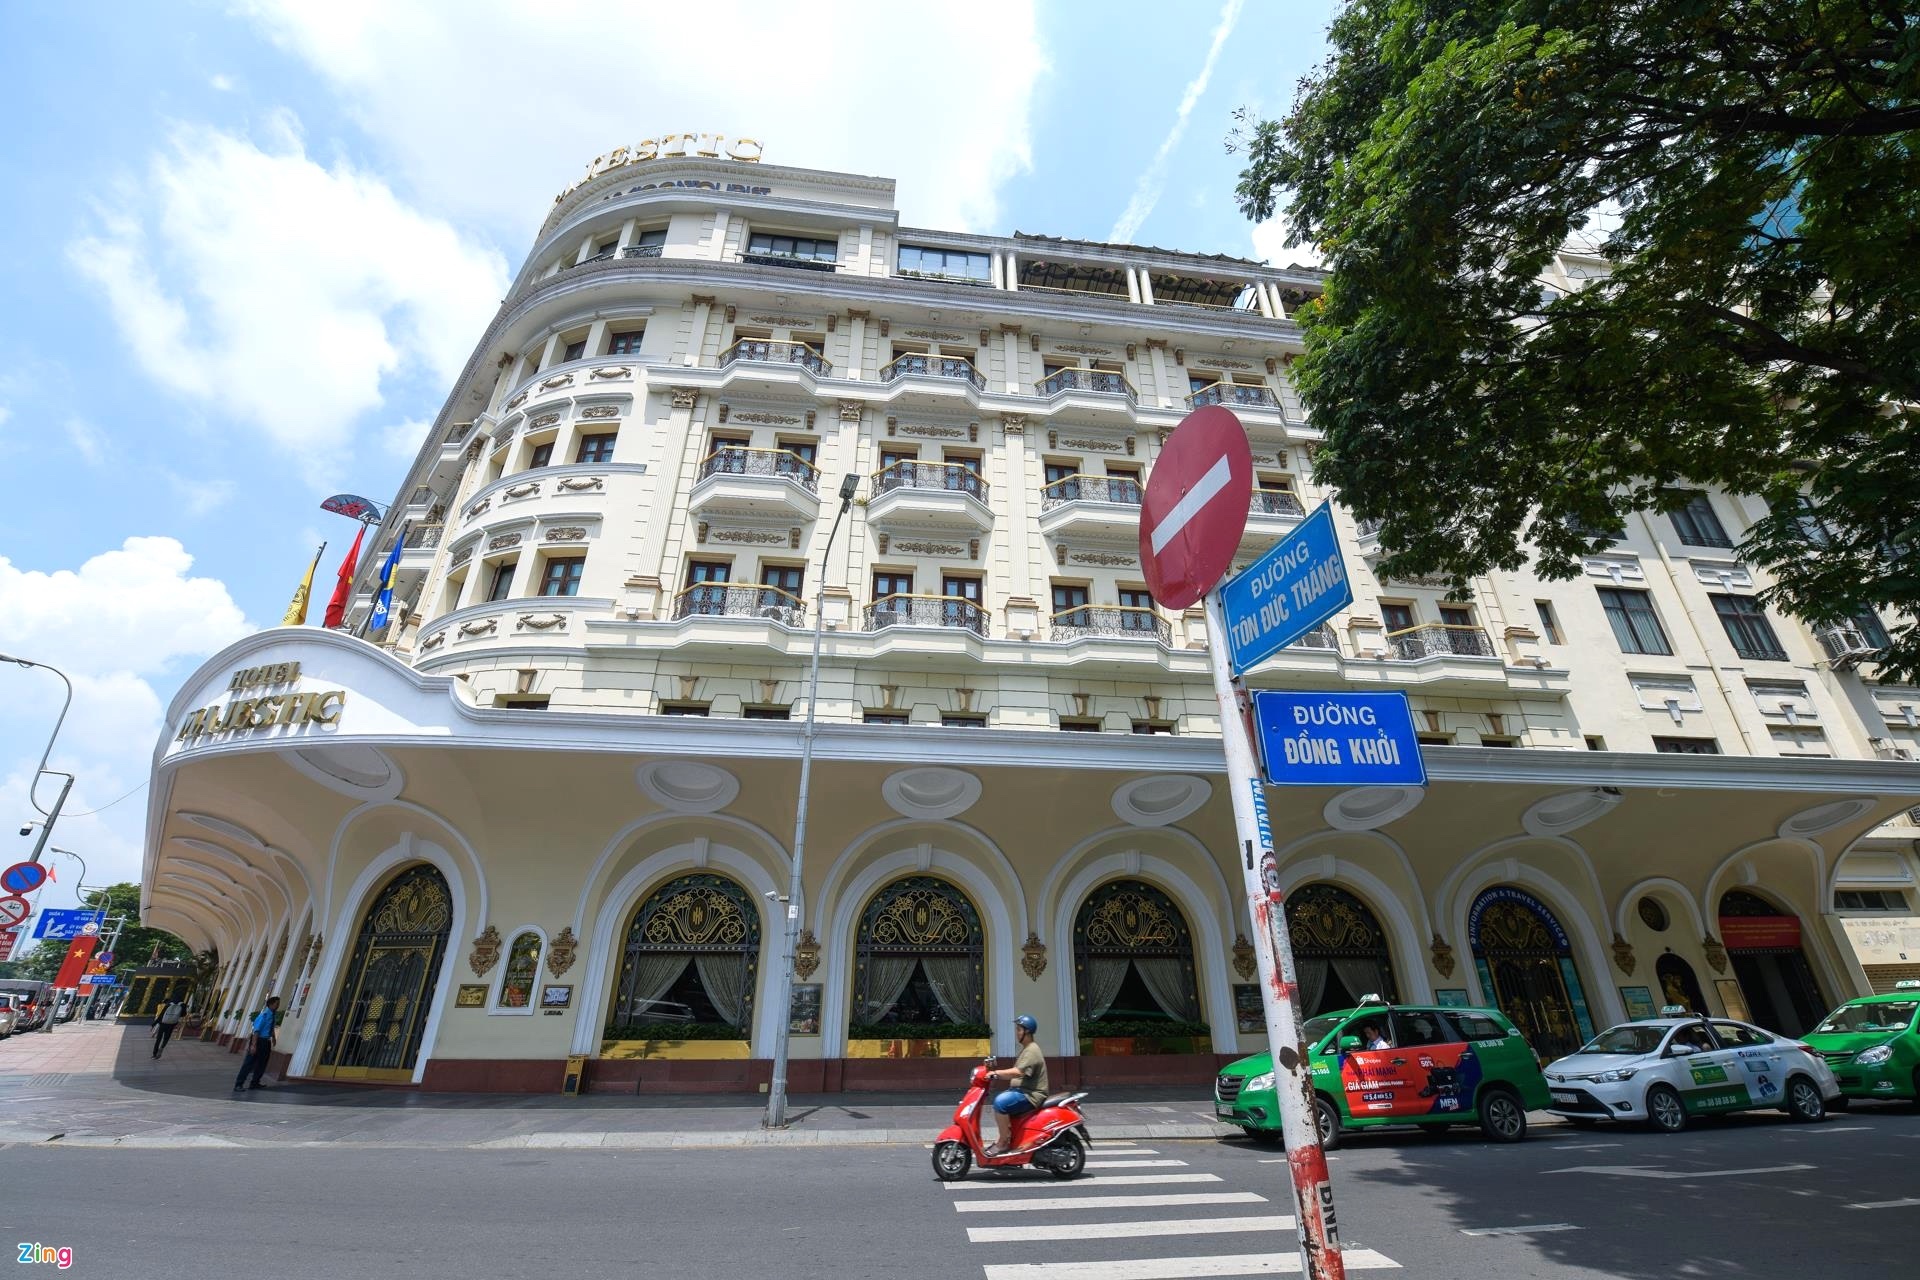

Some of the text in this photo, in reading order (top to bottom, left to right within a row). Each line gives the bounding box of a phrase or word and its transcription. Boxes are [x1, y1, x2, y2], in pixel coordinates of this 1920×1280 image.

[1251, 539, 1310, 601] ĐƯỜNG
[1232, 552, 1344, 651] TÔN ĐỨC THẮNG
[227, 661, 302, 691] HOTEL
[1293, 702, 1377, 726] ĐƯỜNG
[1284, 728, 1400, 765] ĐỒNG KHỞI
[1469, 891, 1499, 937] INFORMATION
[1506, 890, 1536, 907] TRAVEL
[1537, 905, 1565, 938] SERVICE
[1363, 1057, 1382, 1065] Shopee
